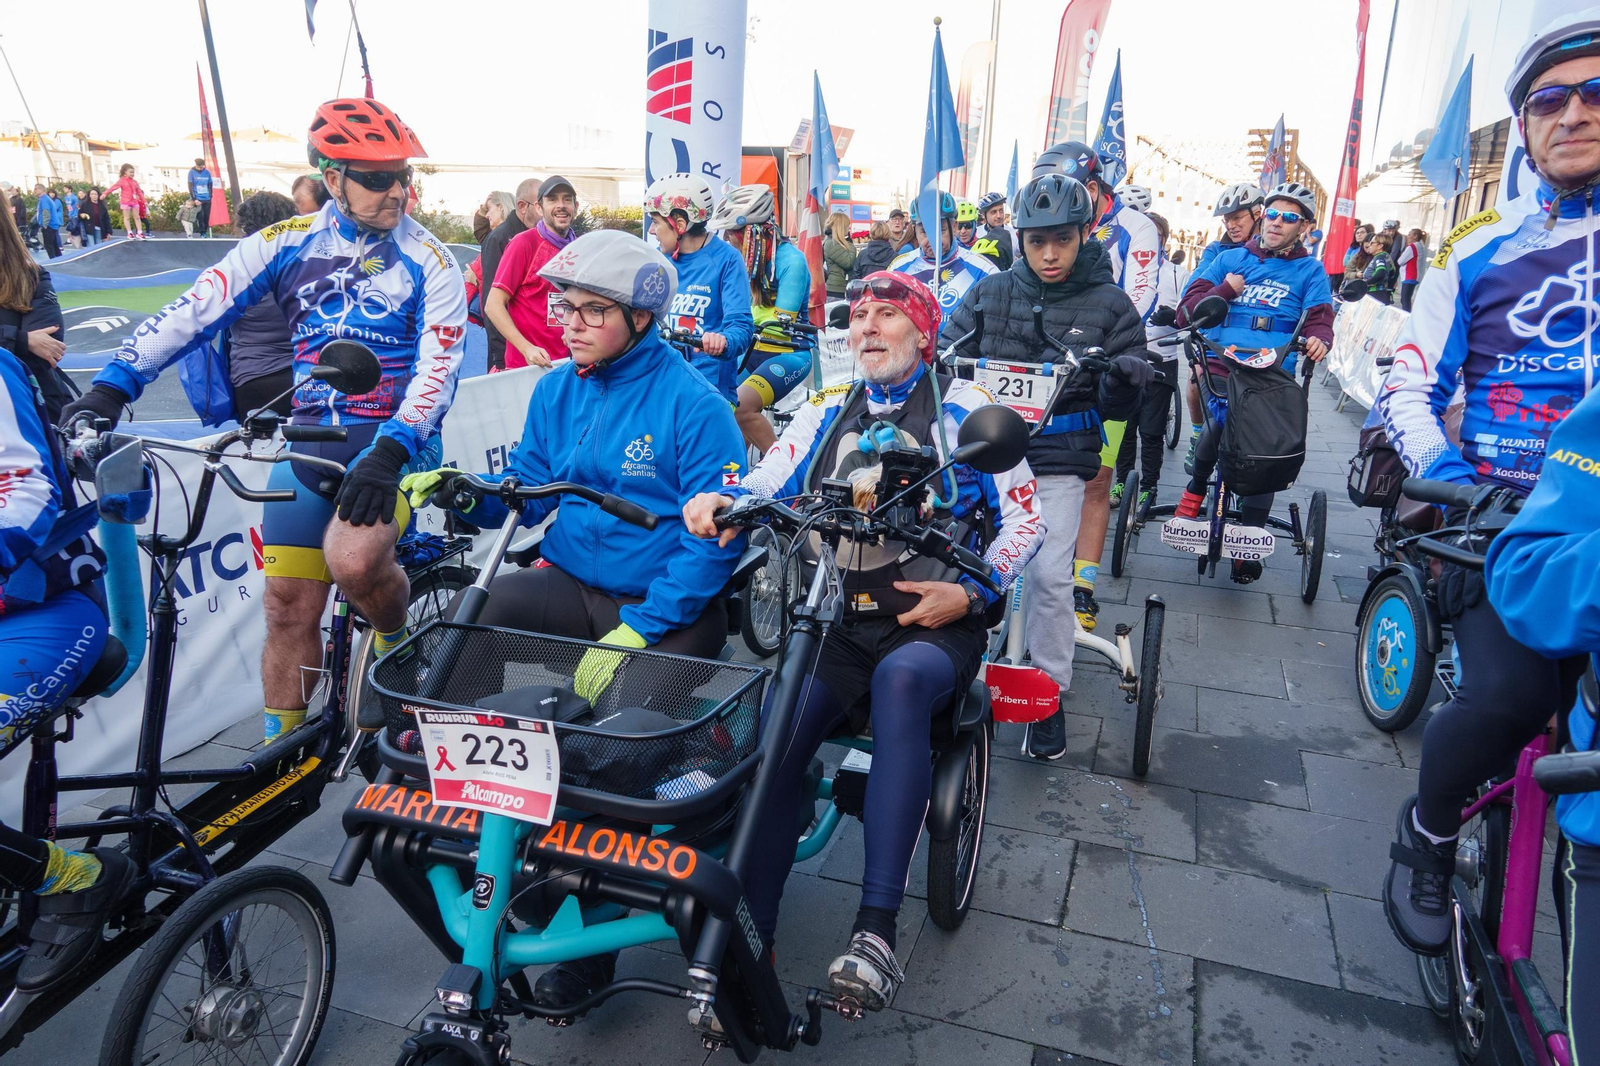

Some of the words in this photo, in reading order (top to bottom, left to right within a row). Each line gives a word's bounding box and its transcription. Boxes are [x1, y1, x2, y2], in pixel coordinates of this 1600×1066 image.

[1496, 353, 1600, 373] DisCa
[997, 376, 1034, 399] 231
[1498, 438, 1545, 449] XUNTA
[1548, 449, 1600, 477] AITOR
[627, 469, 656, 479] Santiag
[1163, 524, 1208, 538] turbo10
[1224, 533, 1273, 546] turbo10
[1172, 544, 1196, 553] VIGO
[1230, 551, 1261, 560] VIGO
[1012, 575, 1024, 613] MANUEL
[0, 624, 96, 727] DisCamino
[999, 695, 1028, 705] ribera
[461, 733, 529, 771] 223
[461, 781, 525, 809] Alcampo
[538, 820, 697, 880] ALONSO
[735, 896, 764, 962] vanraam
[441, 1023, 461, 1035] AXA
